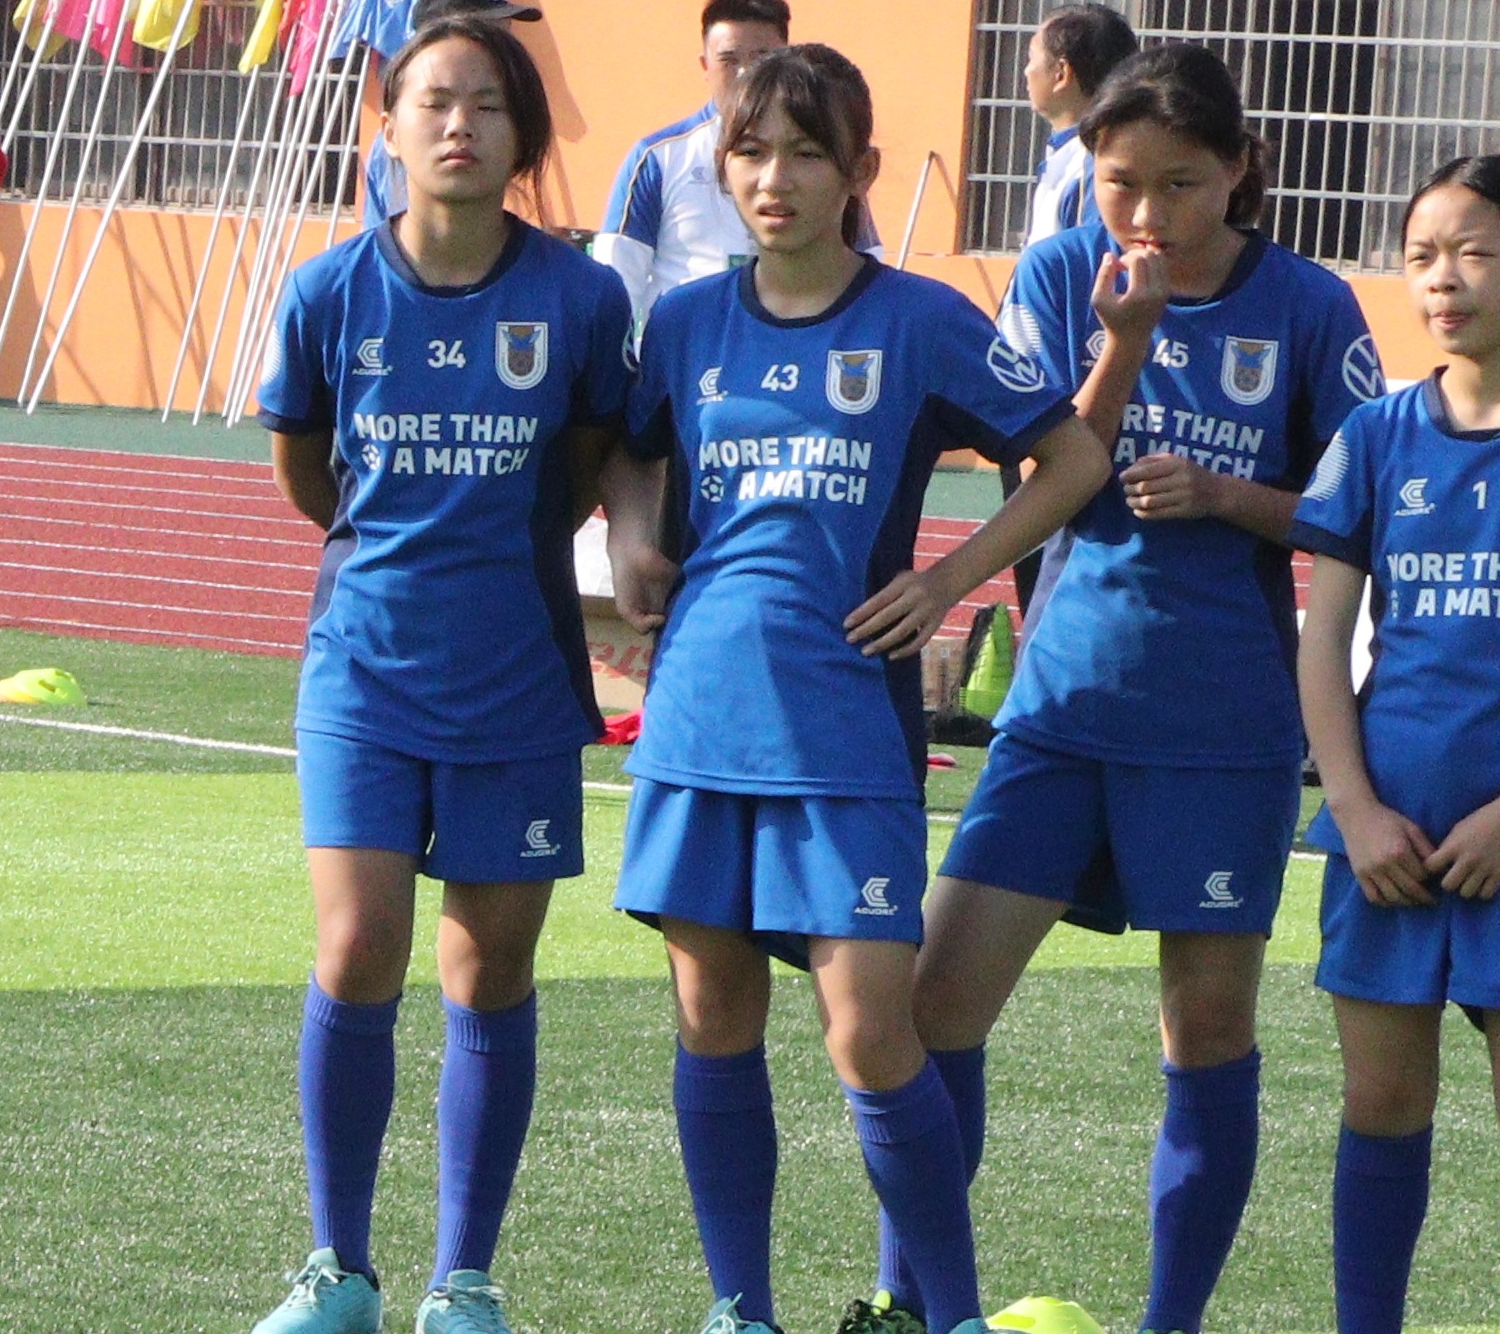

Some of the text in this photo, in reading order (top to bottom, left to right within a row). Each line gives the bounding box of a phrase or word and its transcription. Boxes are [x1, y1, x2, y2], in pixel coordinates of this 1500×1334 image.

[427, 339, 467, 369] 34
[1151, 338, 1189, 368] 45
[760, 363, 800, 392] 43
[354, 412, 538, 442] MORE THAN
[1122, 403, 1264, 455] RE THAN
[392, 447, 529, 476] A MATCH
[699, 436, 872, 472] MORE THAN
[1112, 435, 1137, 464] A
[738, 471, 868, 506] A MATCH
[1386, 552, 1467, 583] MORE
[1414, 587, 1437, 618] A
